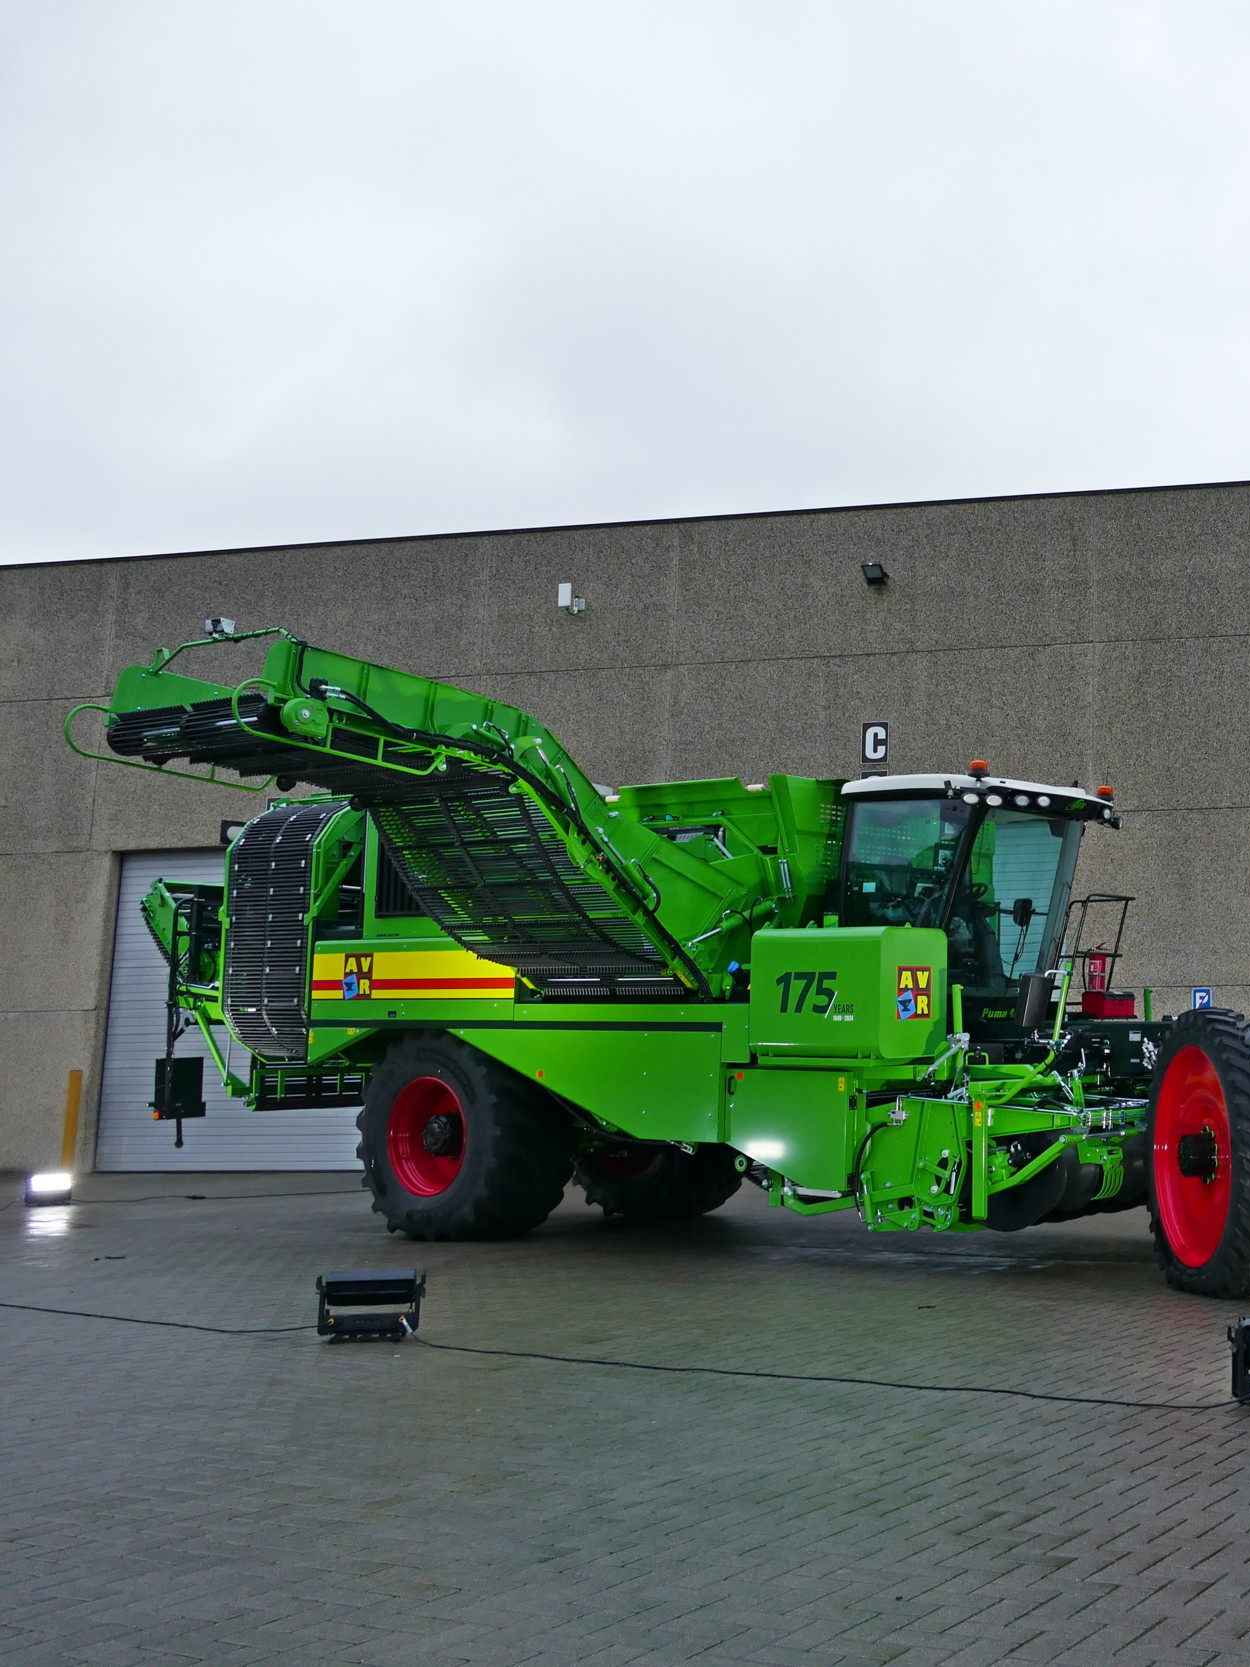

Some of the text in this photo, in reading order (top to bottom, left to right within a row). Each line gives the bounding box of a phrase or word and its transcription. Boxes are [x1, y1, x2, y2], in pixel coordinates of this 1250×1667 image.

[865, 726, 886, 760] C
[775, 971, 837, 1014] 175
[833, 1004, 854, 1014] YEARS
[981, 1007, 1008, 1018] Puma
